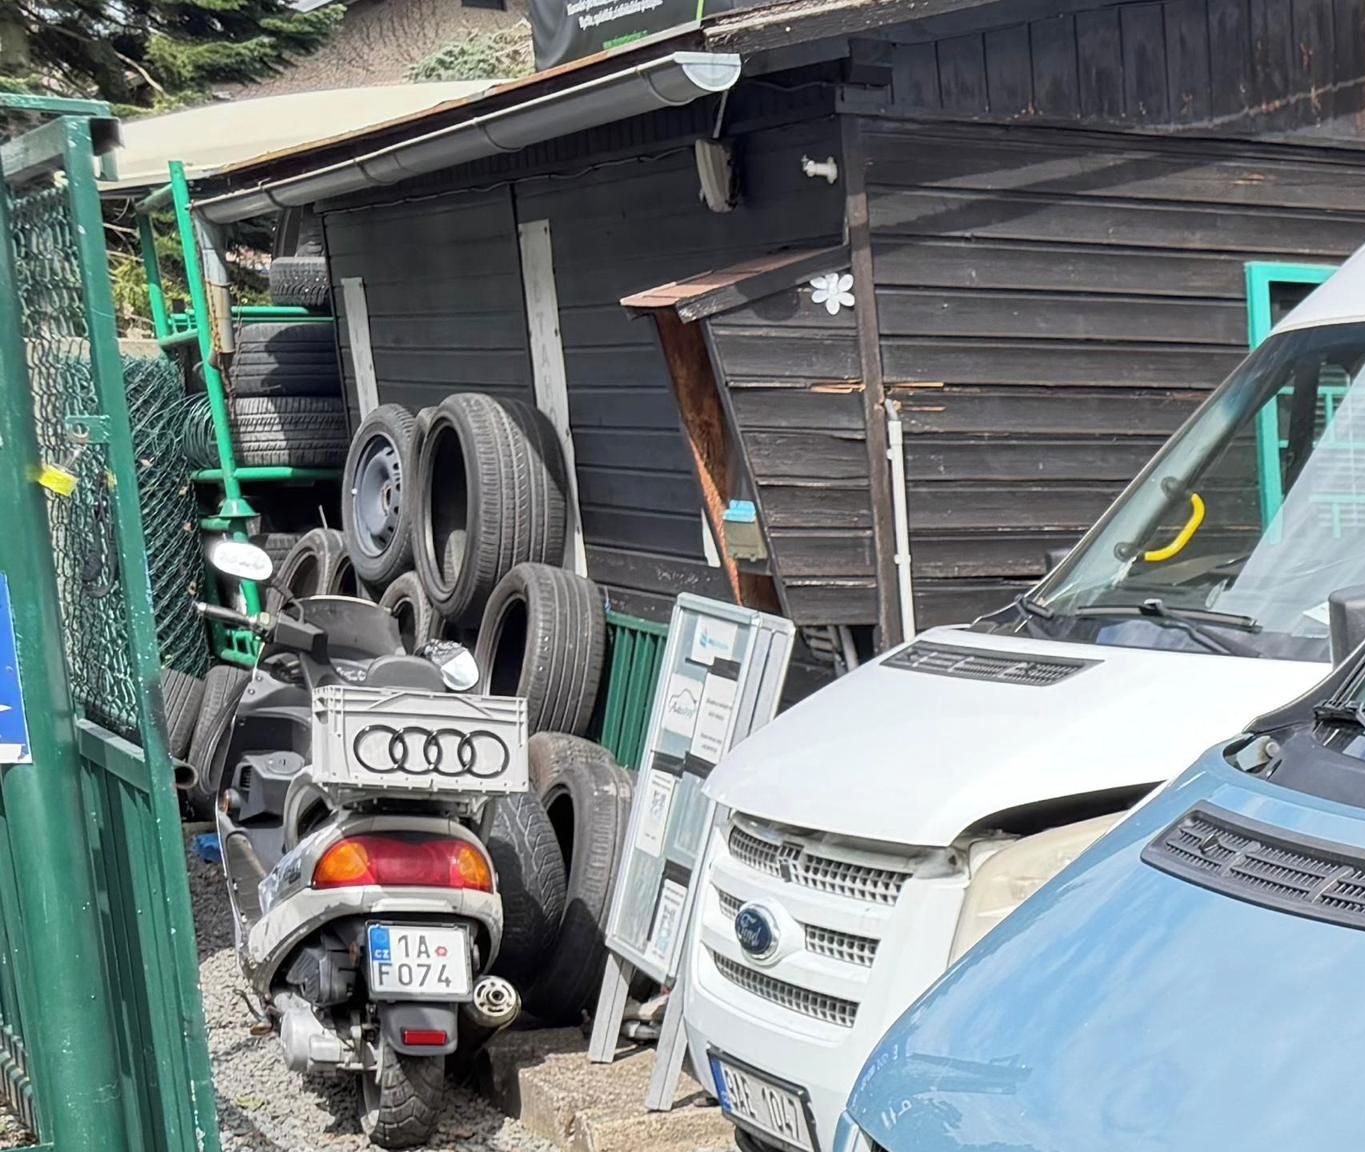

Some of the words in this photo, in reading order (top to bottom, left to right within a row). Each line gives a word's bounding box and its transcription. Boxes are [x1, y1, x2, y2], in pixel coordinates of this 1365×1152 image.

[737, 913, 762, 946] Ford
[375, 949, 389, 958] CZ
[398, 935, 430, 958] 1A
[379, 963, 451, 987] F074
[762, 1087, 800, 1141] 1047
